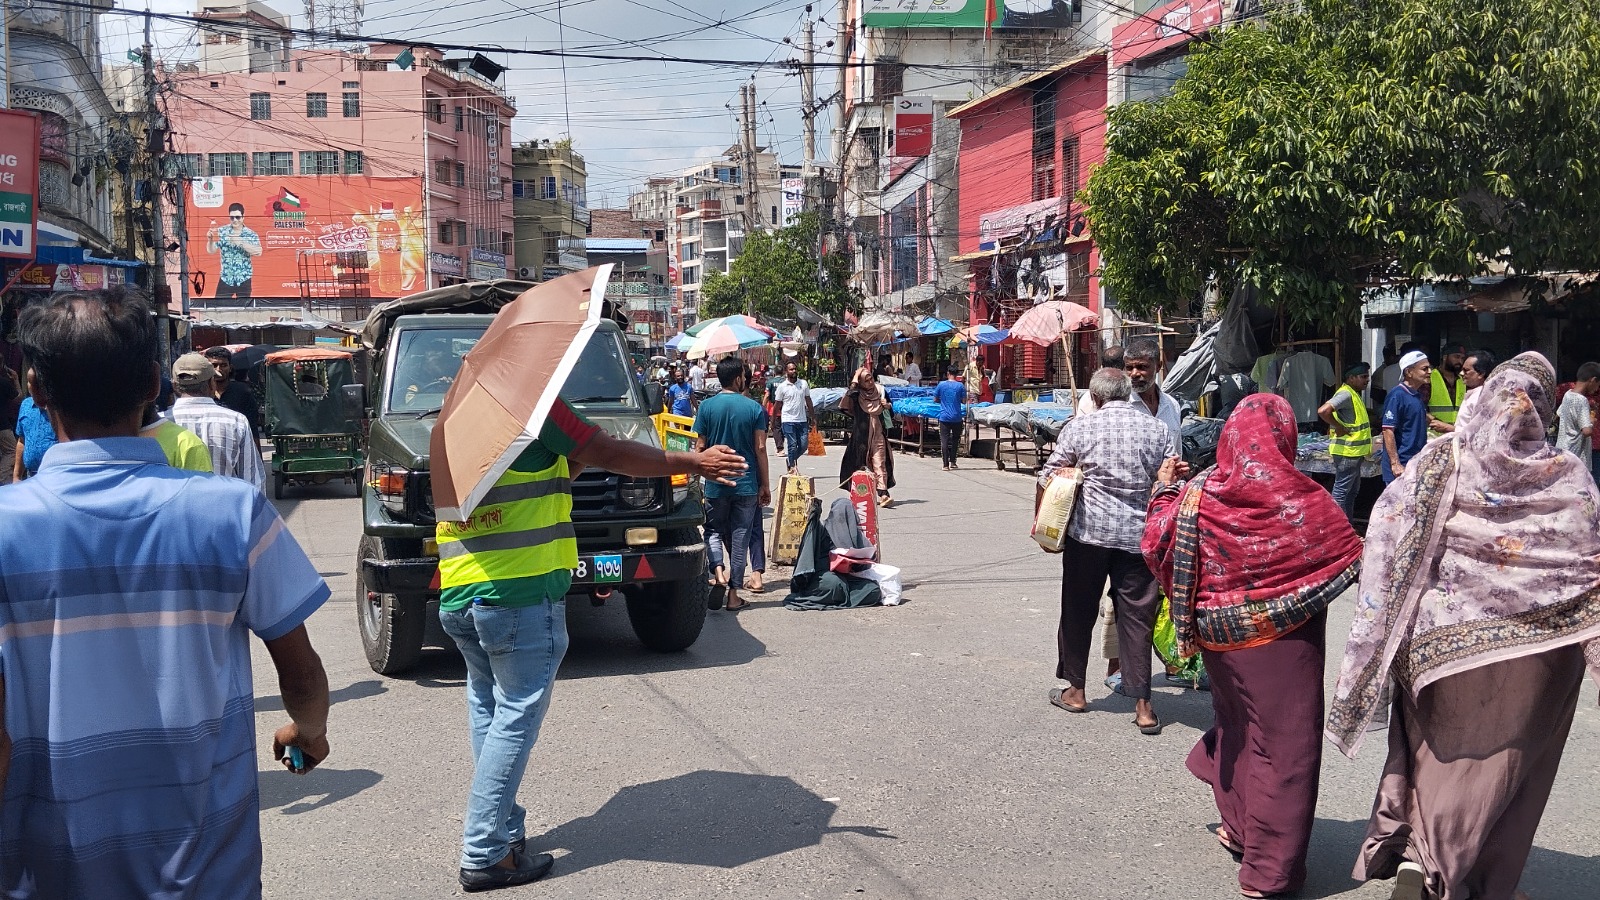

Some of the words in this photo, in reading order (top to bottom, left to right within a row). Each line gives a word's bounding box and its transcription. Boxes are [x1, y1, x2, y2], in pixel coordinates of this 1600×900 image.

[786, 189, 801, 201] el
[3, 202, 27, 213] রাজশাহী
[273, 211, 306, 221] SUPPORT
[274, 221, 306, 229] PALESTINE
[0, 228, 23, 247] N
[789, 506, 804, 516] আই
[480, 508, 503, 529] শাখা
[570, 560, 588, 578] ৪
[596, 559, 621, 578] ৭৩৬
